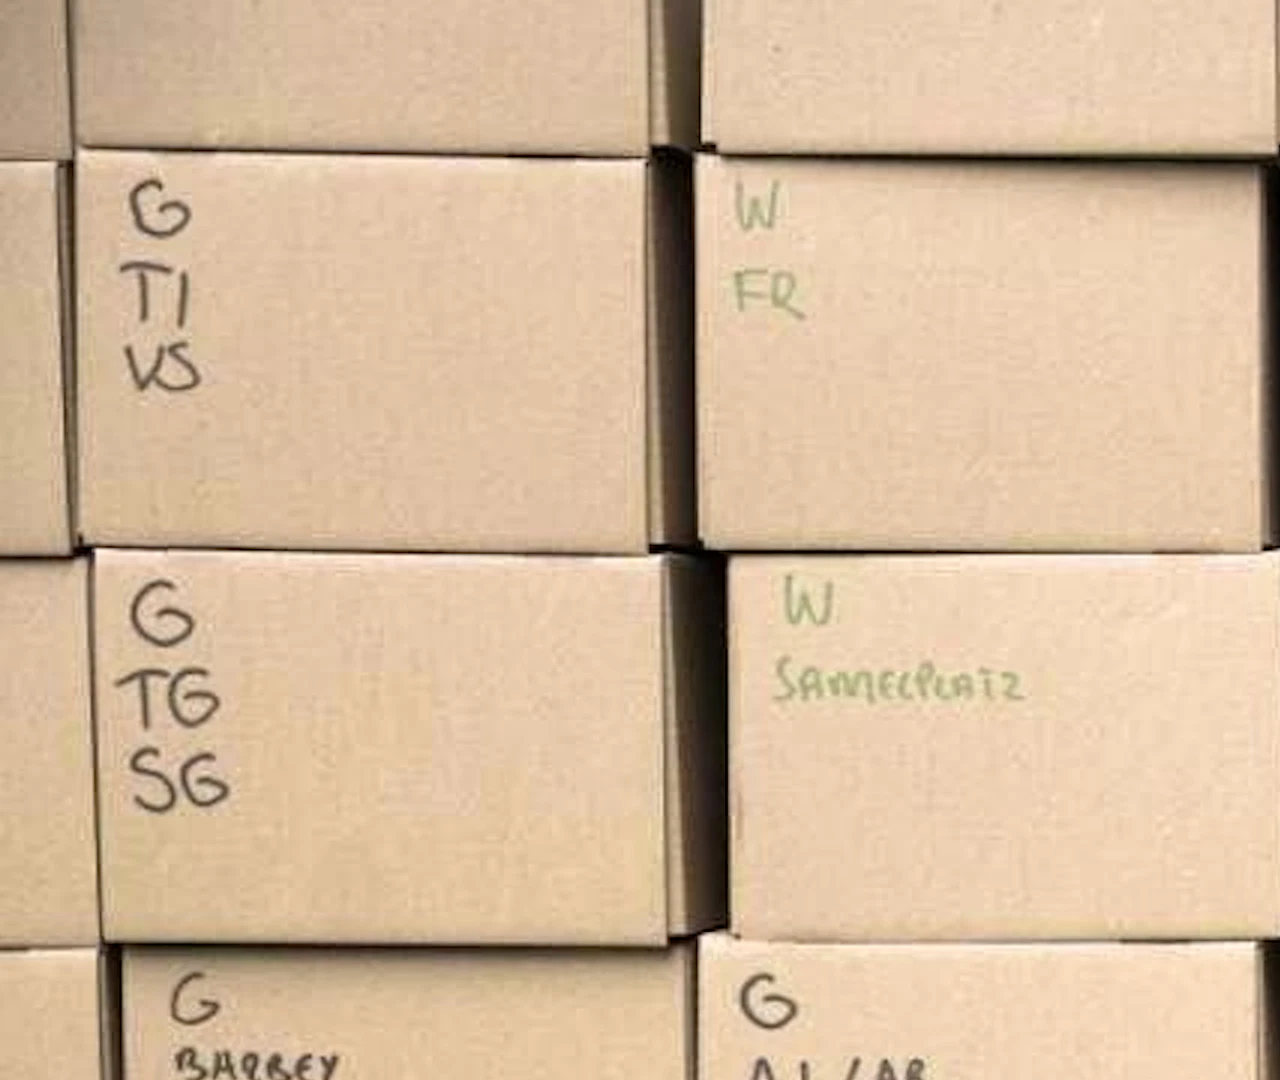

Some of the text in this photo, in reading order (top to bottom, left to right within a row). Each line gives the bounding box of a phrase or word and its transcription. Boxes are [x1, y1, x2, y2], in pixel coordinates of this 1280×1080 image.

[129, 178, 191, 239] G
[736, 179, 780, 231] W
[119, 261, 189, 328] TI
[733, 269, 805, 320] FR
[124, 341, 200, 392] VS
[130, 580, 195, 647] G
[784, 574, 833, 625] W
[115, 667, 220, 729] TG
[130, 747, 229, 814] SG
[169, 971, 221, 1026] G
[739, 973, 798, 1030] G
